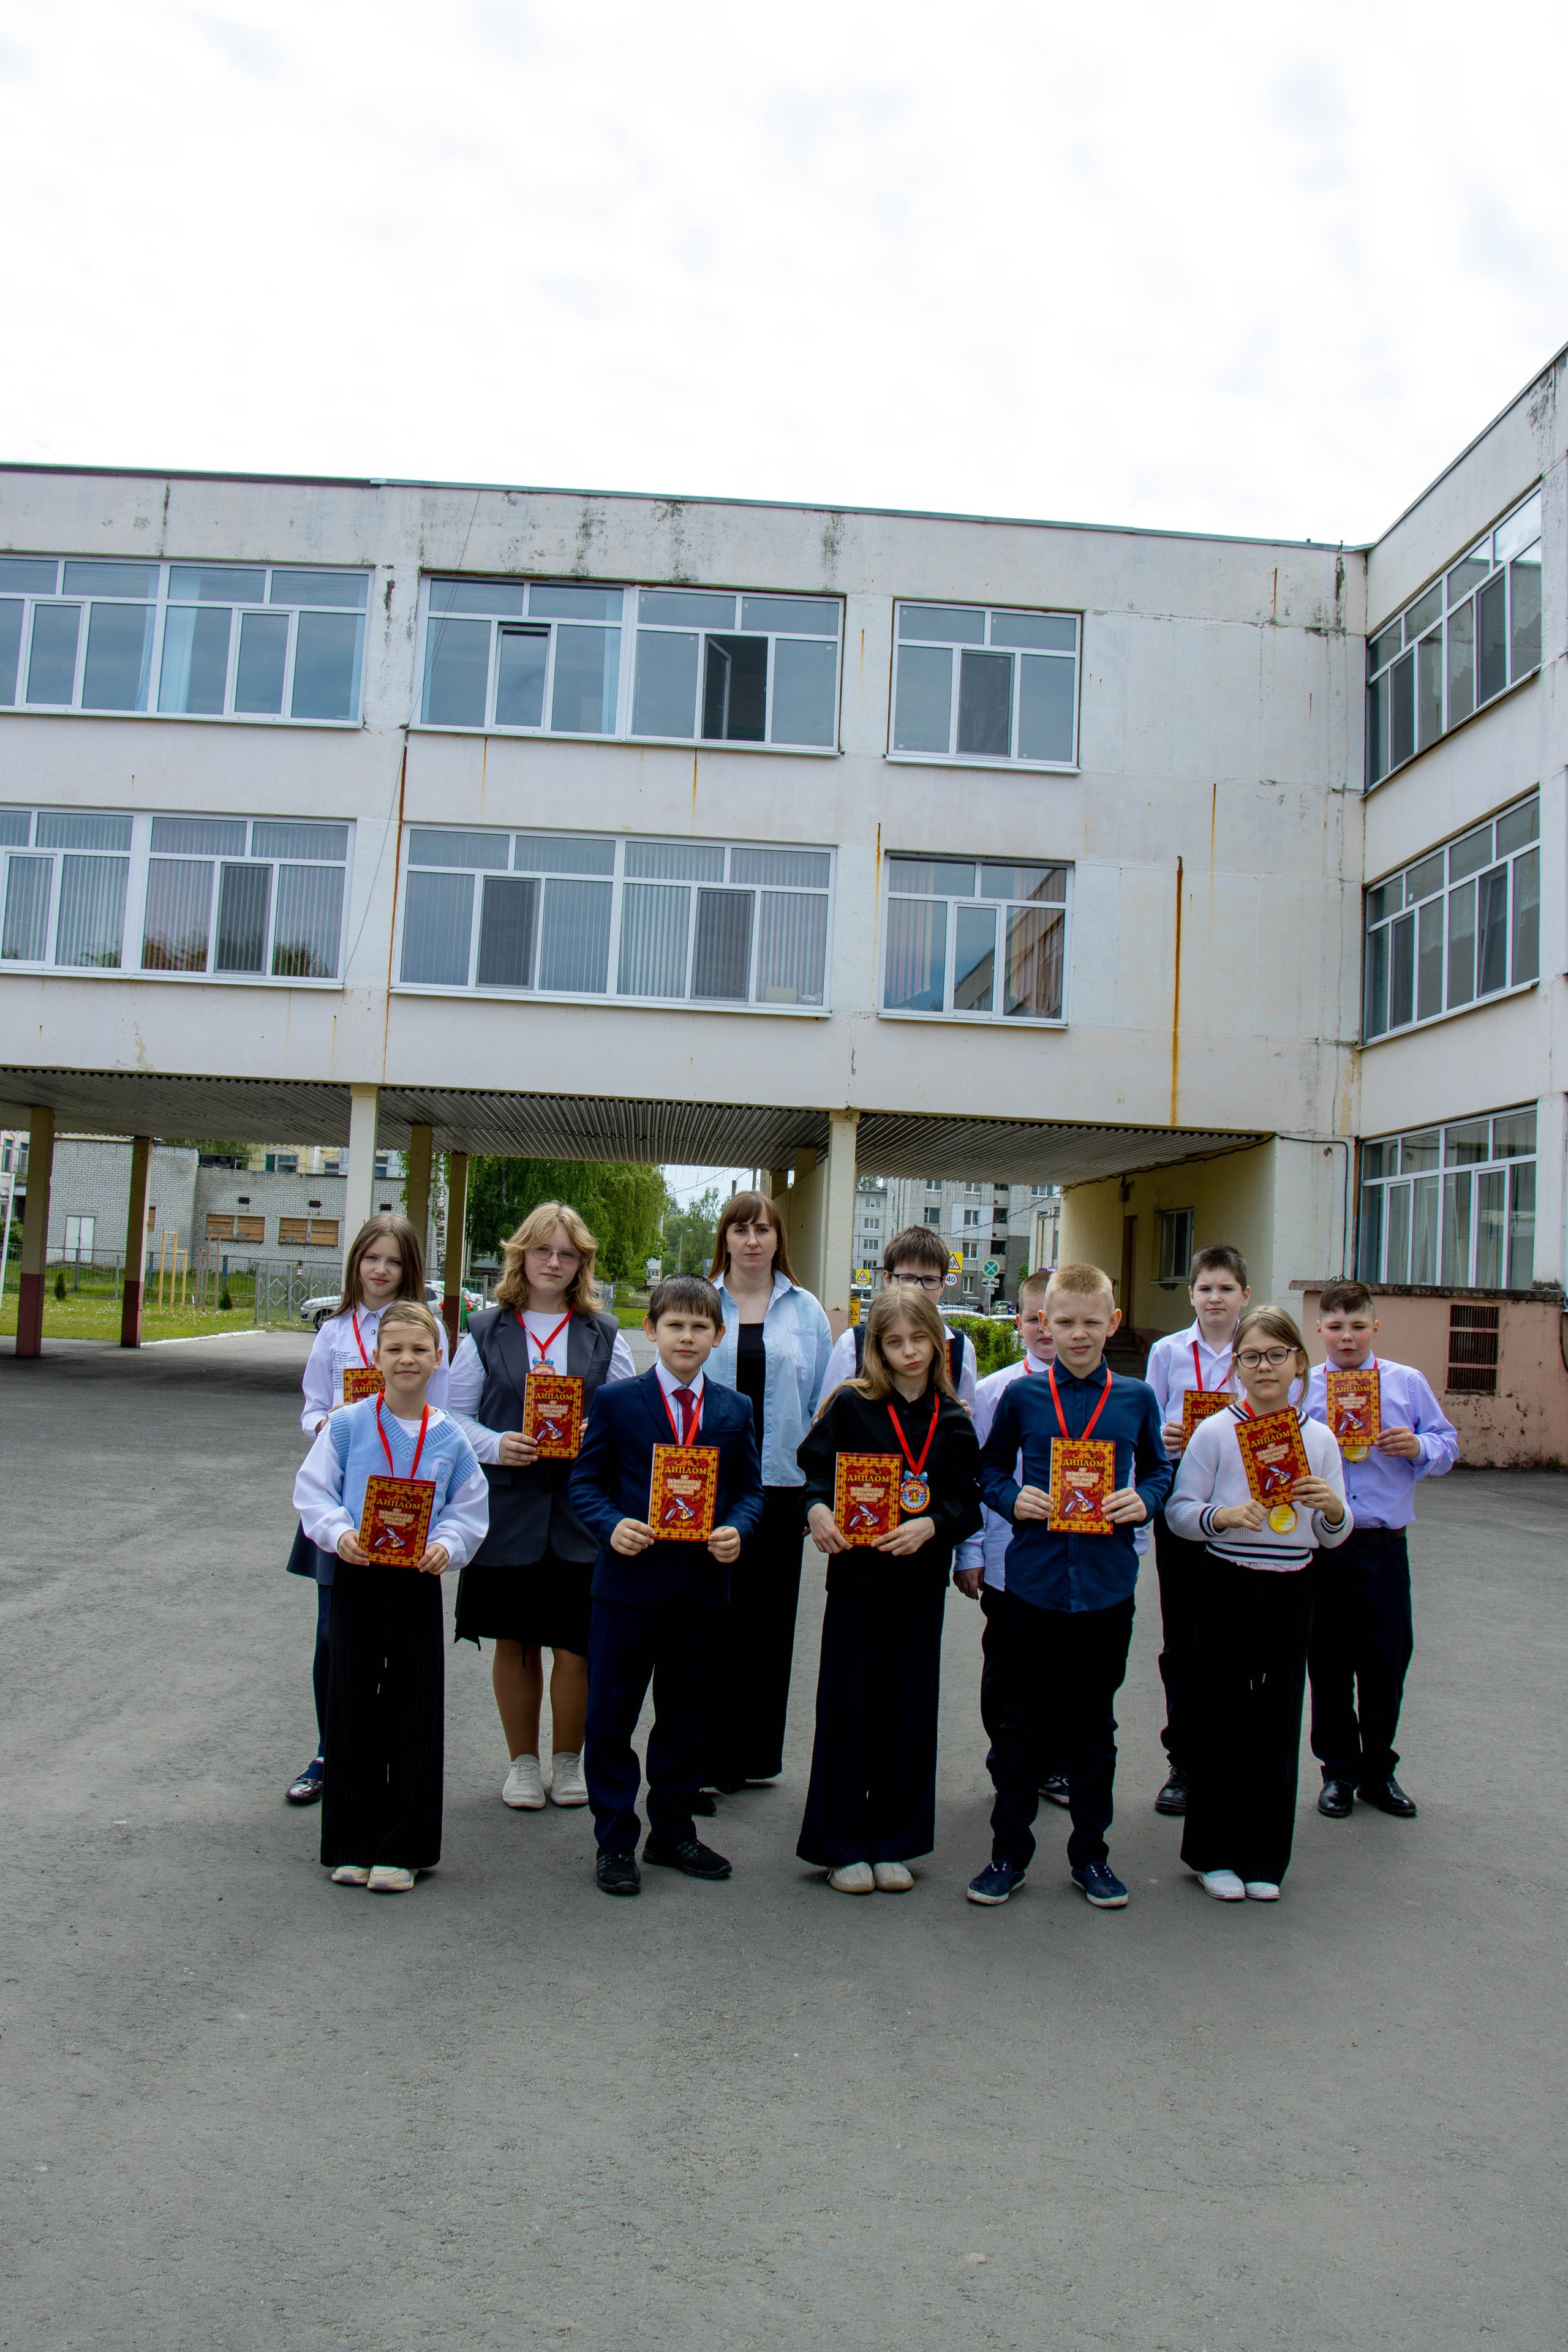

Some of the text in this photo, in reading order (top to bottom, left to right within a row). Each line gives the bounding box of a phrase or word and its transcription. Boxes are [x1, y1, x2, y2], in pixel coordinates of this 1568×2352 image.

[1251, 1430, 1291, 1448] ДИПЛОМ
[1063, 1459, 1104, 1468] ДИПЛОМ
[665, 1466, 707, 1475] ДИПЛОМ
[847, 1474, 889, 1483] ДИПЛОМ
[377, 1498, 421, 1510] ДИПЛОМ
